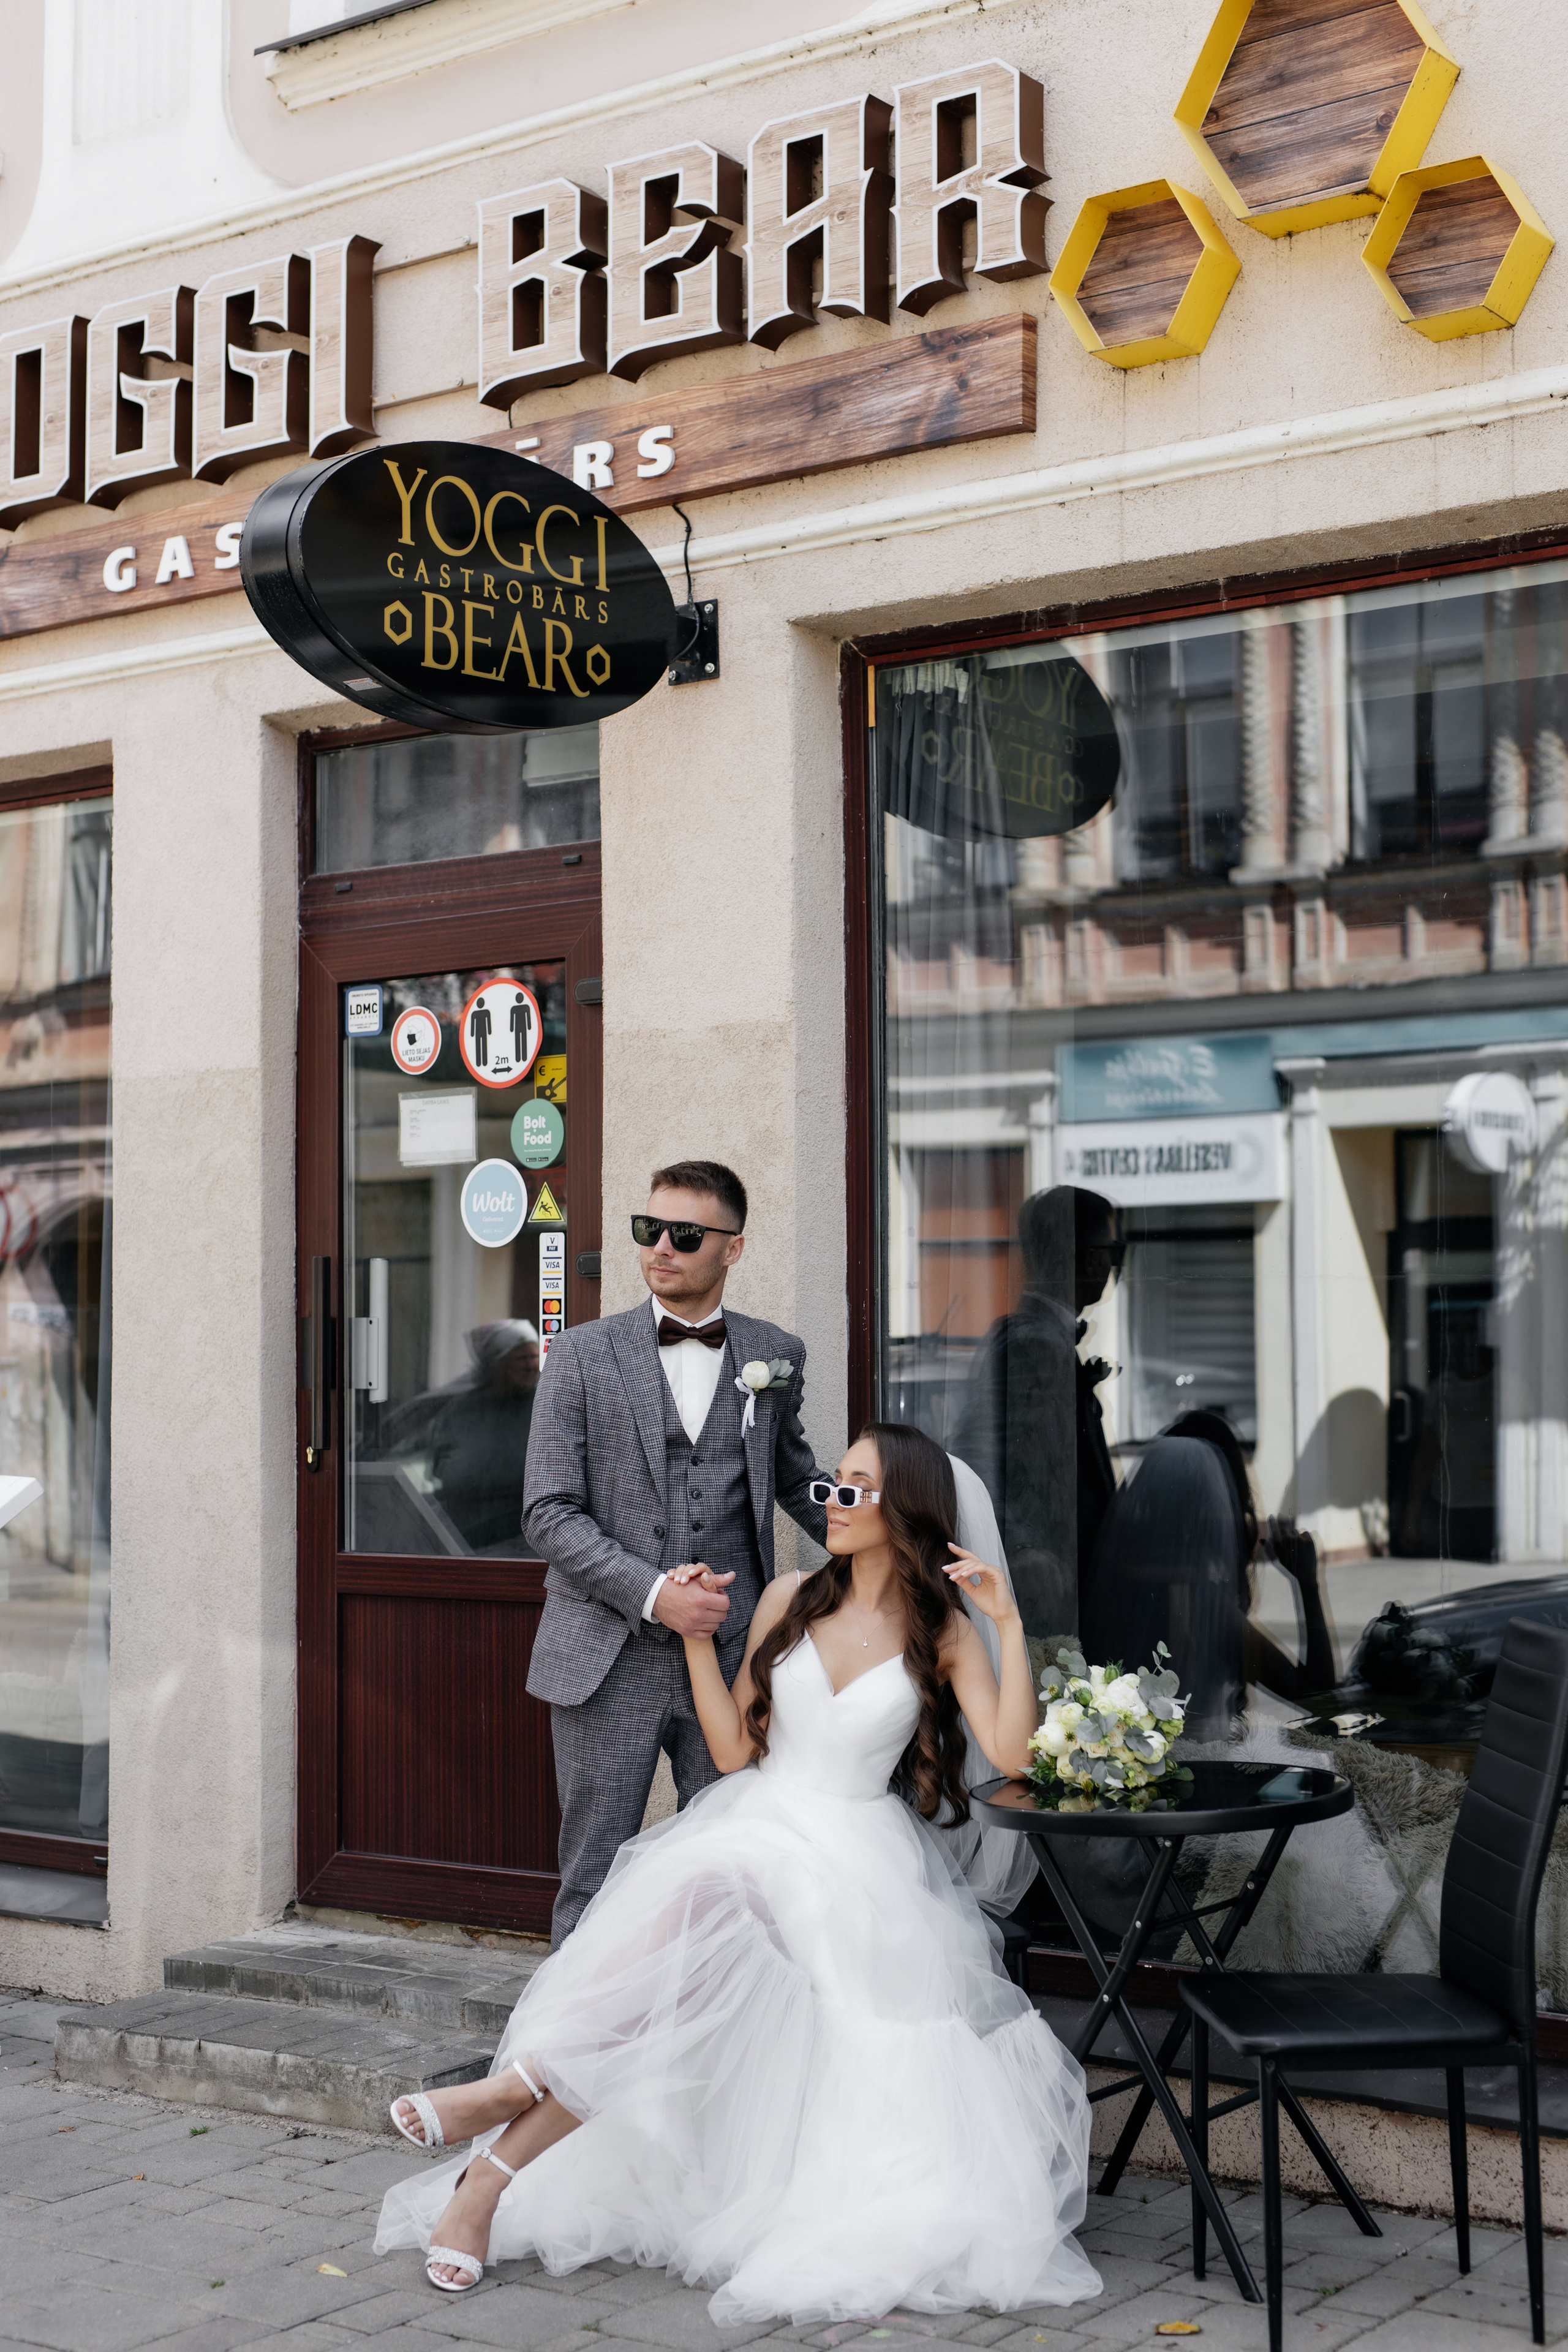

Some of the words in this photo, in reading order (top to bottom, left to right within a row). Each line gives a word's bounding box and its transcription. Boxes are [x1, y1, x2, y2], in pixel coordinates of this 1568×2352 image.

[475, 57, 1055, 412] BEAR
[383, 459, 610, 592] YOGGI
[387, 552, 608, 624] GASTROBĀRS
[421, 591, 590, 698] BEAR
[350, 1003, 377, 1015] LDMC
[495, 1056, 509, 1065] 2m
[524, 1115, 546, 1132] Bolt
[524, 1131, 552, 1145] Food
[472, 1191, 516, 1213] Wolt
